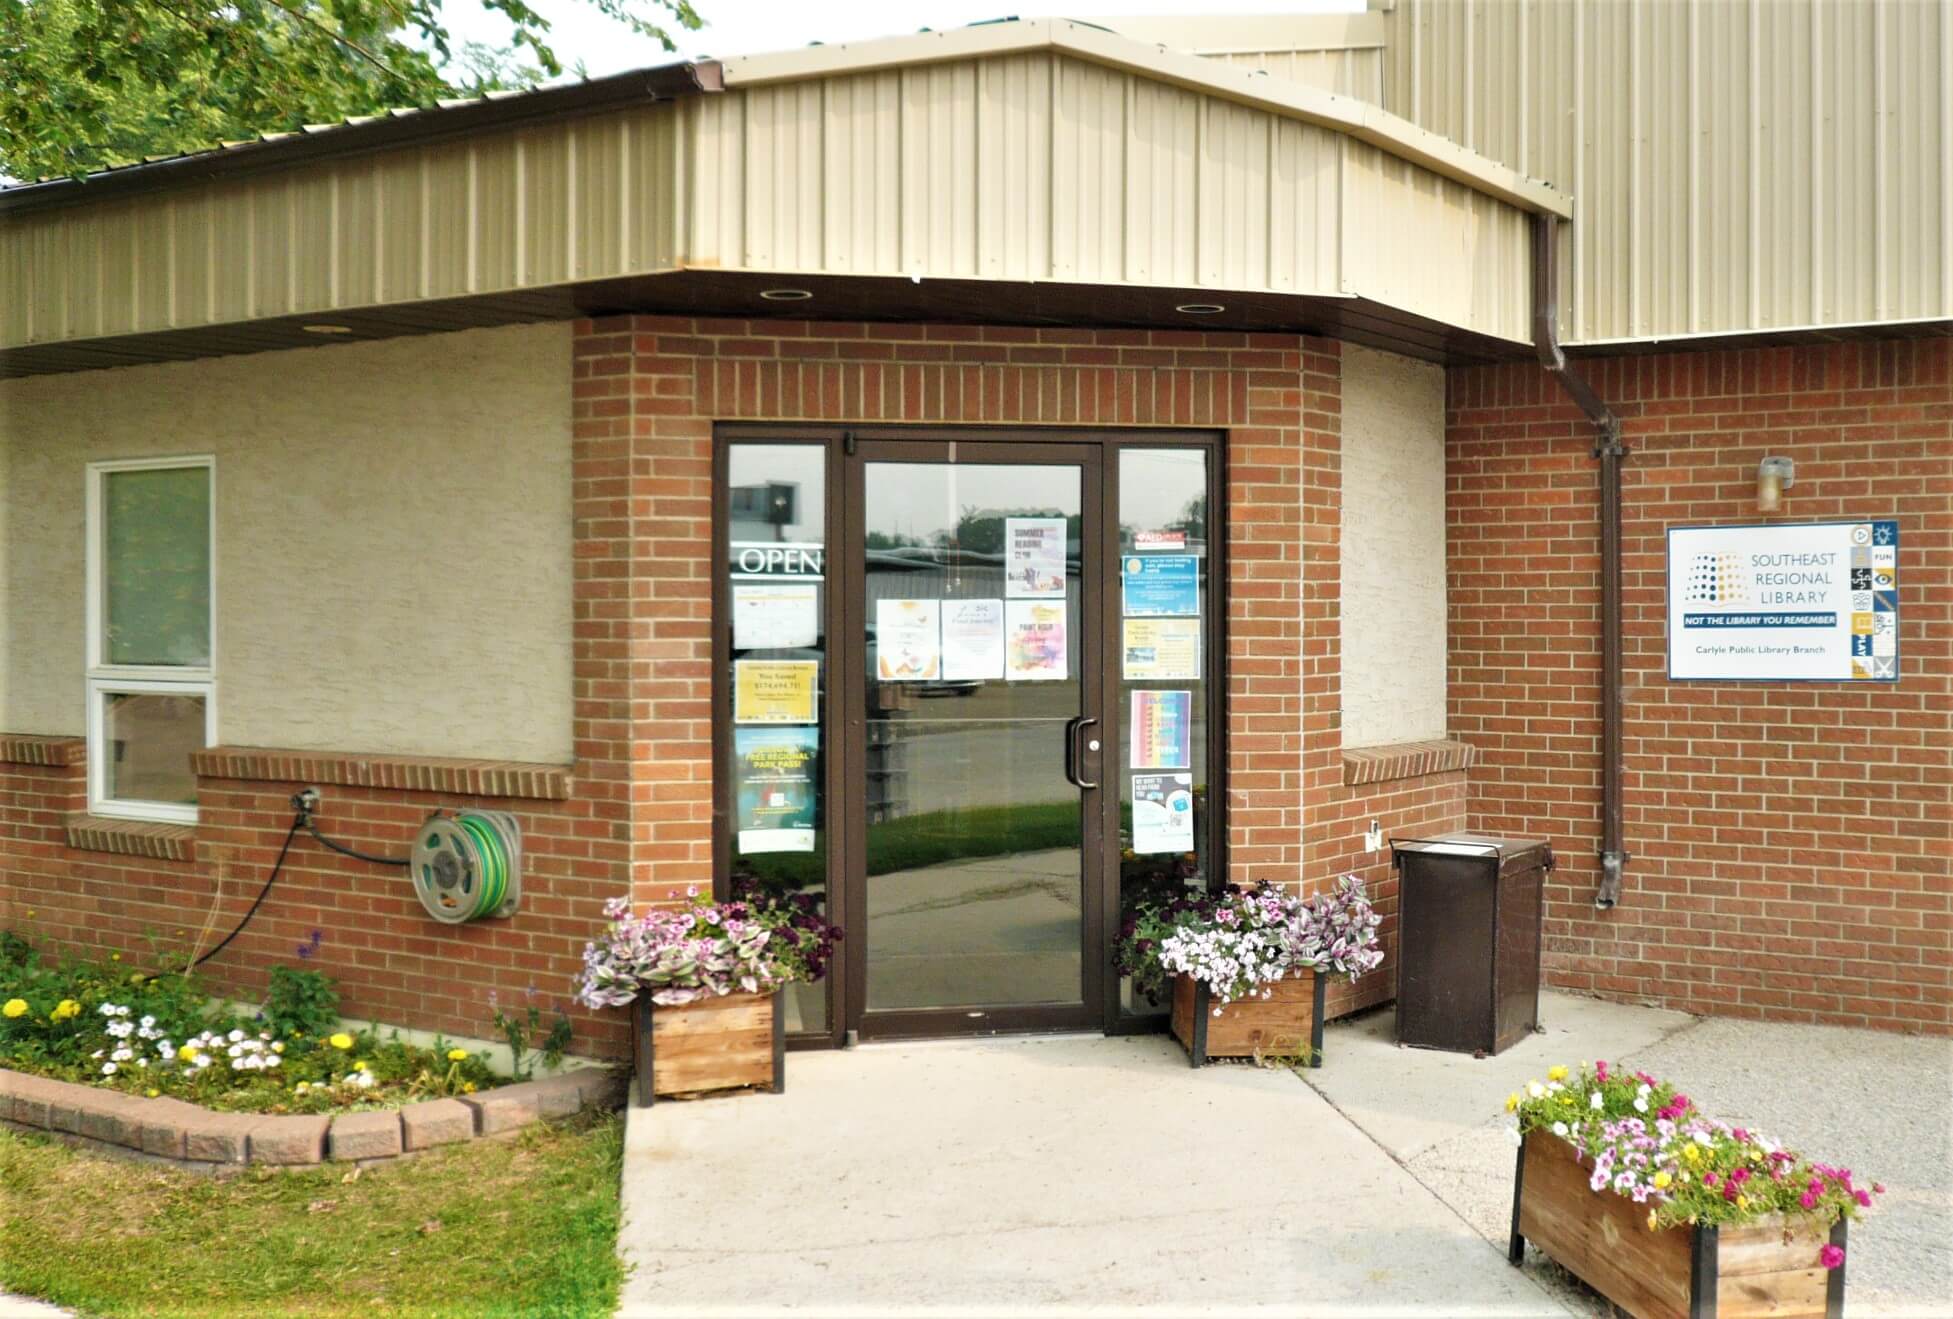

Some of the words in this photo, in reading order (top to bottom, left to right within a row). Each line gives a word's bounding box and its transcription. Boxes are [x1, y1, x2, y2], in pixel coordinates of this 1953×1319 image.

[1015, 529, 1044, 537] SUMMER
[739, 548, 821, 574] OPEN
[1751, 552, 1836, 567] SOUTHEAST
[1756, 572, 1832, 585] REGIONAL
[1761, 591, 1827, 604] LIBRARY
[1685, 616, 1704, 625] NOT
[1707, 616, 1724, 624] THE
[1726, 616, 1761, 624] LIBRARY
[1763, 616, 1782, 624] YOU
[1784, 616, 1836, 624] REMEMBER
[1696, 646, 1727, 656] Carlyle
[1729, 646, 1755, 654] Public
[1758, 646, 1791, 656] Library
[1793, 646, 1826, 654] Branch
